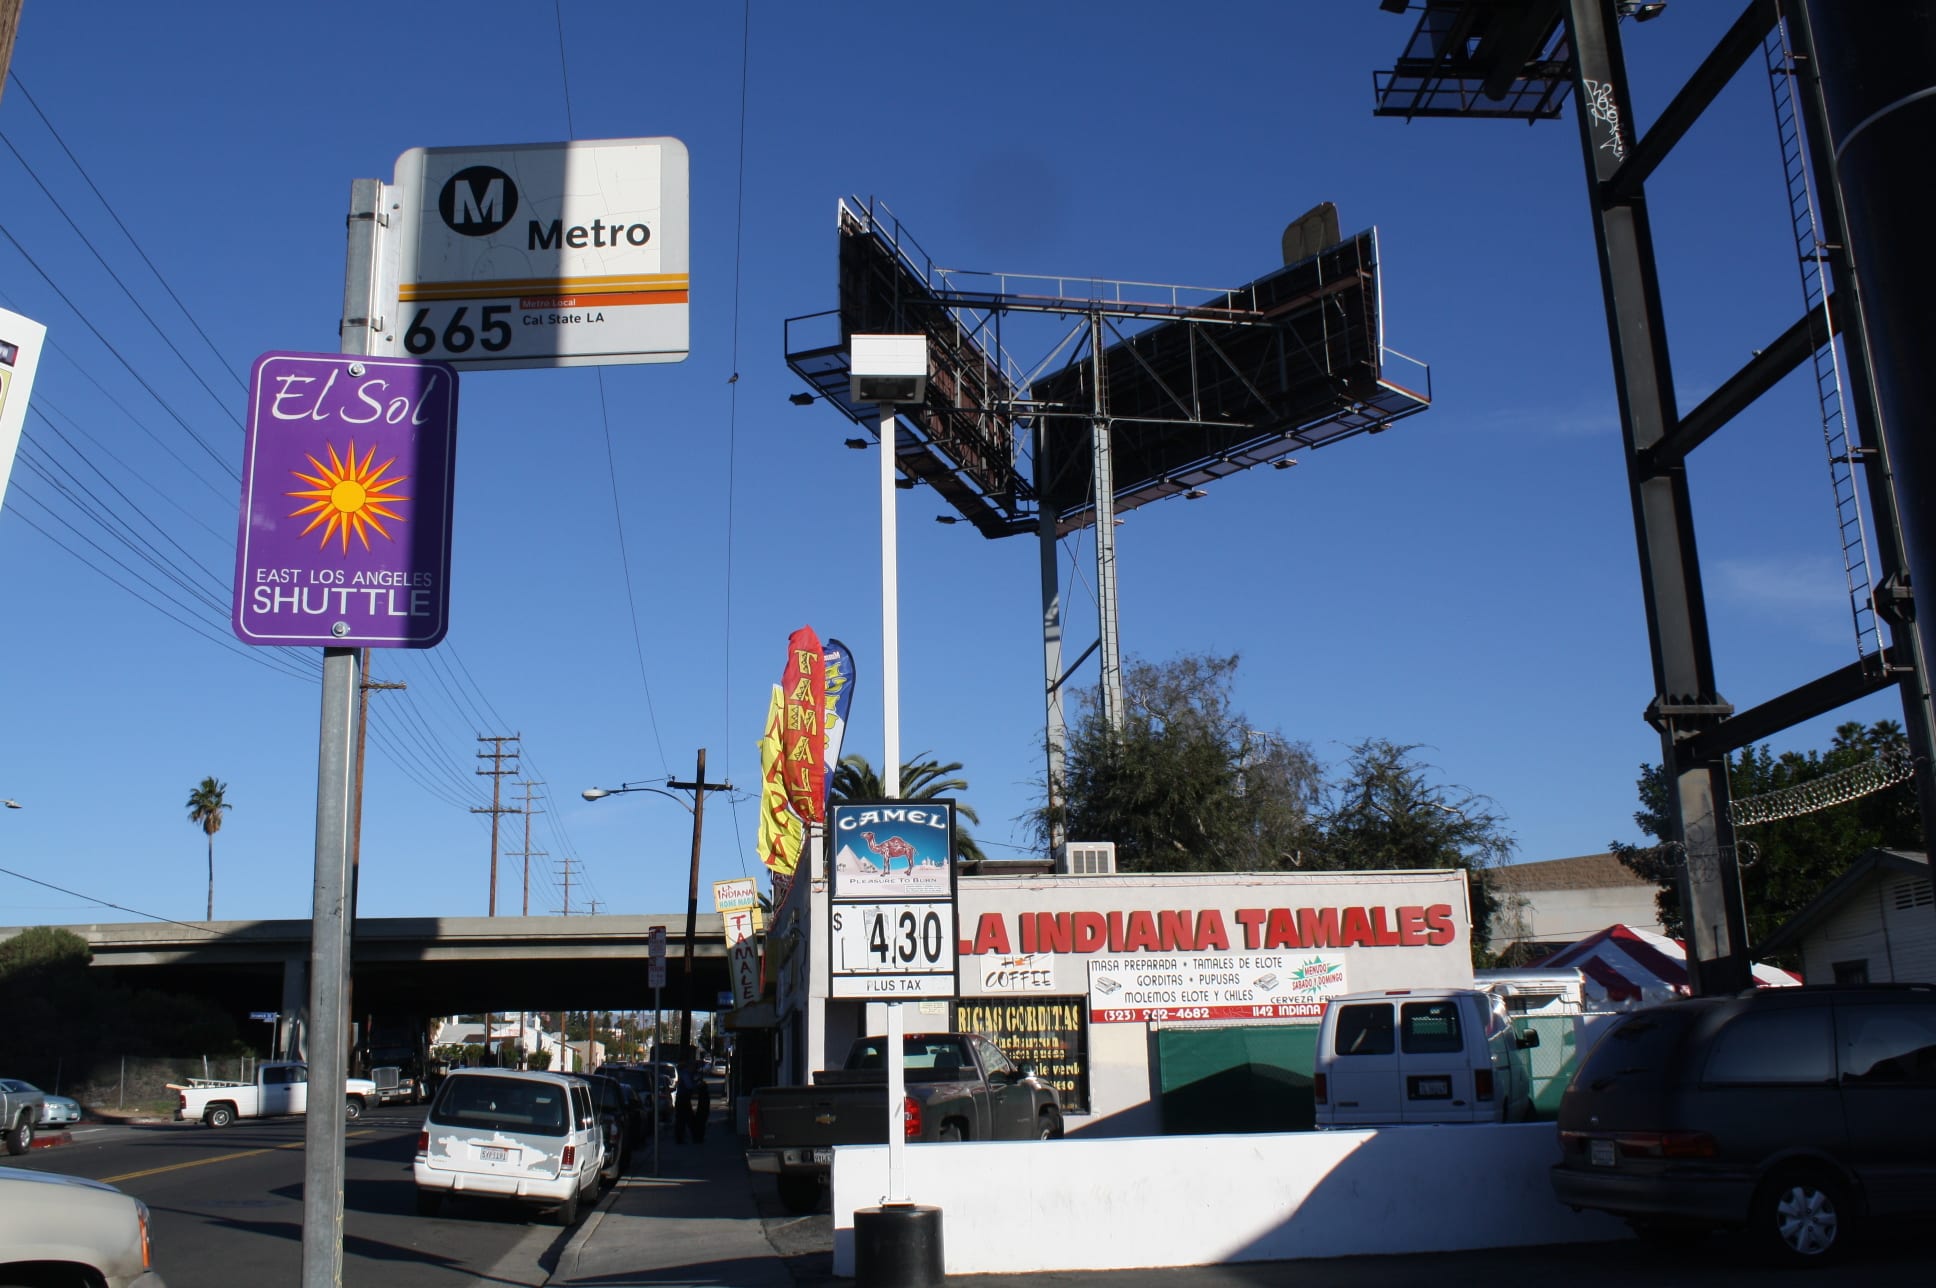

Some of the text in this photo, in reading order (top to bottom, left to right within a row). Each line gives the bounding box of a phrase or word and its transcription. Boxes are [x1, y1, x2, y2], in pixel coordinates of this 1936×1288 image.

[453, 177, 505, 225] M
[528, 217, 651, 251] Metro
[523, 298, 576, 308] Metro Local
[523, 312, 604, 326] Cal State LA
[403, 304, 514, 355] 665
[270, 367, 437, 427] El Sol
[256, 568, 433, 587] EAST LOS ANGELES
[252, 585, 432, 617] SHUTTLE
[838, 808, 947, 831] CAMEL
[717, 888, 753, 900] INDIANA
[1018, 909, 1231, 954] INDIANA
[1235, 903, 1456, 951] TAMALES
[1091, 956, 1283, 972] MASA PREPARADA TAMALES DE ELOTE
[1304, 963, 1327, 977] MENUDO
[900, 979, 922, 991] TAX
[985, 969, 1052, 990] COFFEE
[1136, 973, 1240, 987] GORDITAS PUPUSAS
[1292, 978, 1313, 991] SABADO
[1319, 972, 1343, 986] DOMINGO
[1124, 991, 1177, 1004] MOLEMOS
[1181, 990, 1209, 1002] ELOTE
[1224, 989, 1254, 1001] CHILES
[1270, 995, 1314, 1004] CERVEZA
[958, 1006, 1002, 1033] RICAS
[1006, 1005, 1079, 1032] GORDITAS
[1104, 1009, 1136, 1022] (323)
[1252, 1005, 1274, 1017] 1142
[1278, 1004, 1321, 1016] INDIANA
